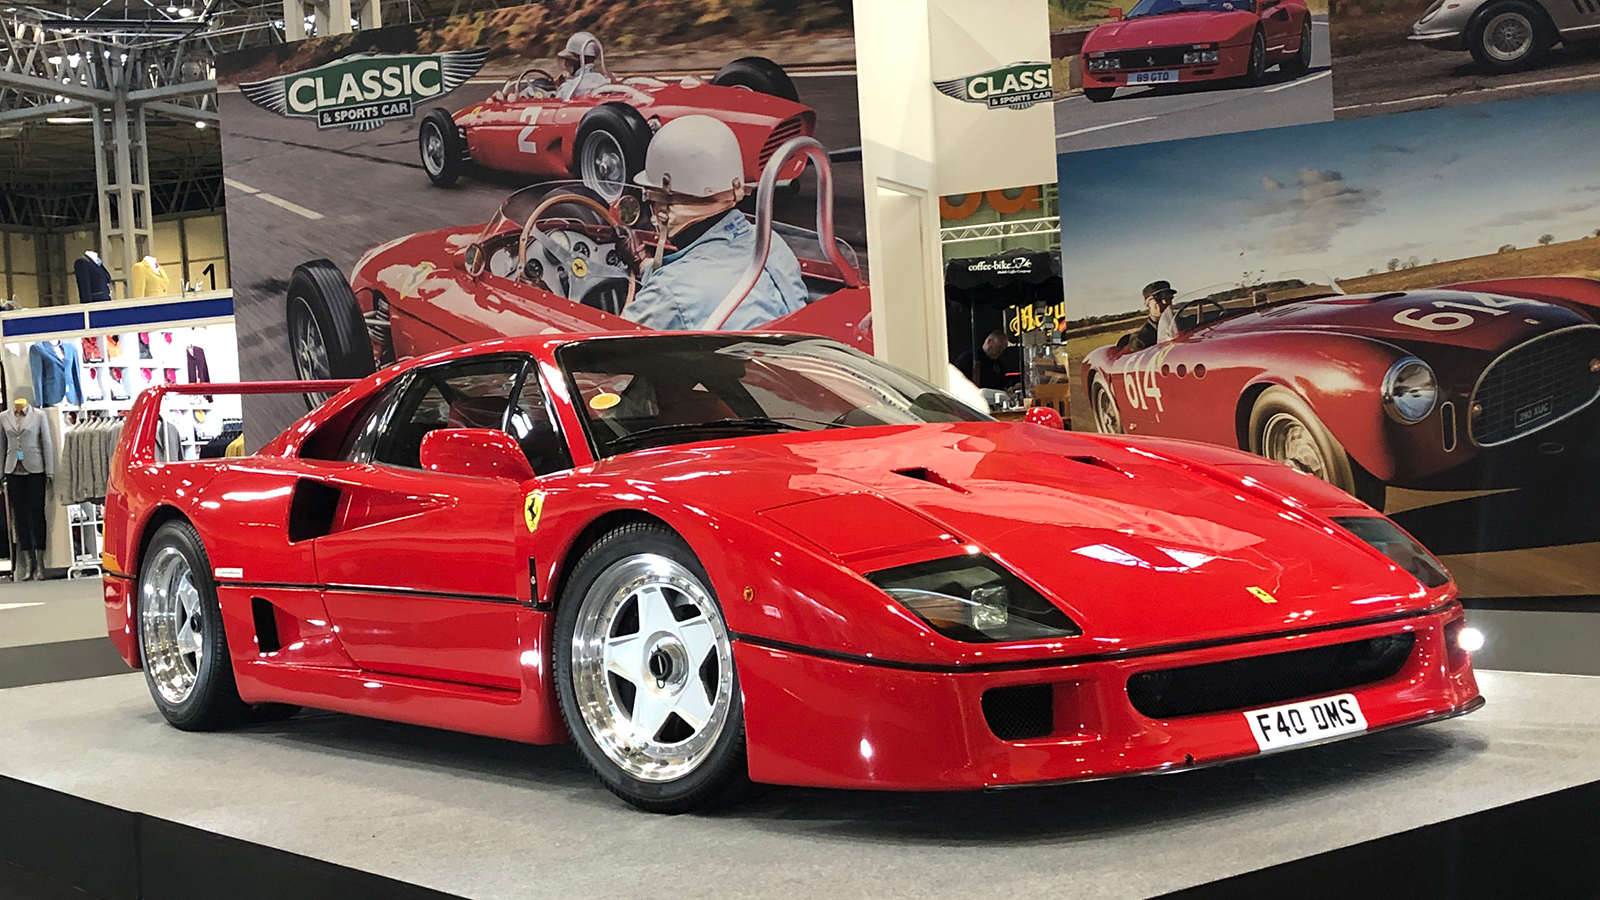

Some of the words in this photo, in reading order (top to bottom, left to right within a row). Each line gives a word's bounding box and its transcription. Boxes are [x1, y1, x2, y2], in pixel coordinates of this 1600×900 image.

[288, 60, 441, 113] CLASSIC
[991, 98, 998, 106] &
[1000, 93, 1031, 105] SPORTS
[1032, 90, 1052, 100] CAR
[322, 112, 332, 123] &
[334, 105, 379, 122] SPORTS
[381, 101, 409, 115] CAR
[517, 106, 543, 154] 2
[202, 263, 216, 291] 1
[1392, 294, 1551, 331] 614
[1123, 350, 1164, 412] 614
[1256, 713, 1307, 742] F40
[1309, 698, 1356, 730] DMS
